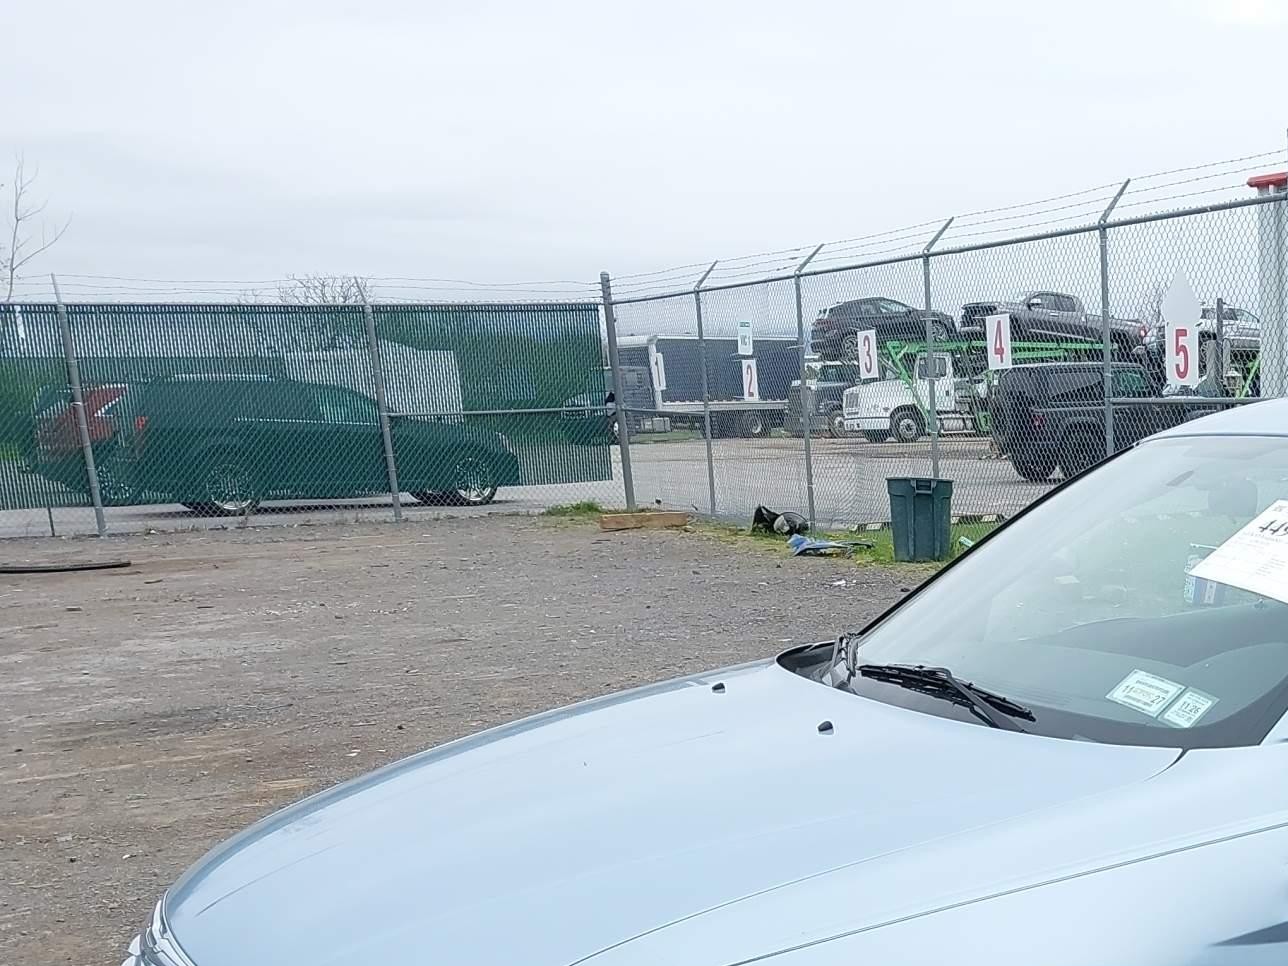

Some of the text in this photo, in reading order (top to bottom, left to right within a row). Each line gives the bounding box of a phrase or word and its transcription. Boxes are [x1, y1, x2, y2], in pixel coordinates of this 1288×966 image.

[863, 334, 873, 374] 3
[994, 319, 1005, 363] 4
[1175, 328, 1189, 379] 5
[746, 364, 755, 398] 2
